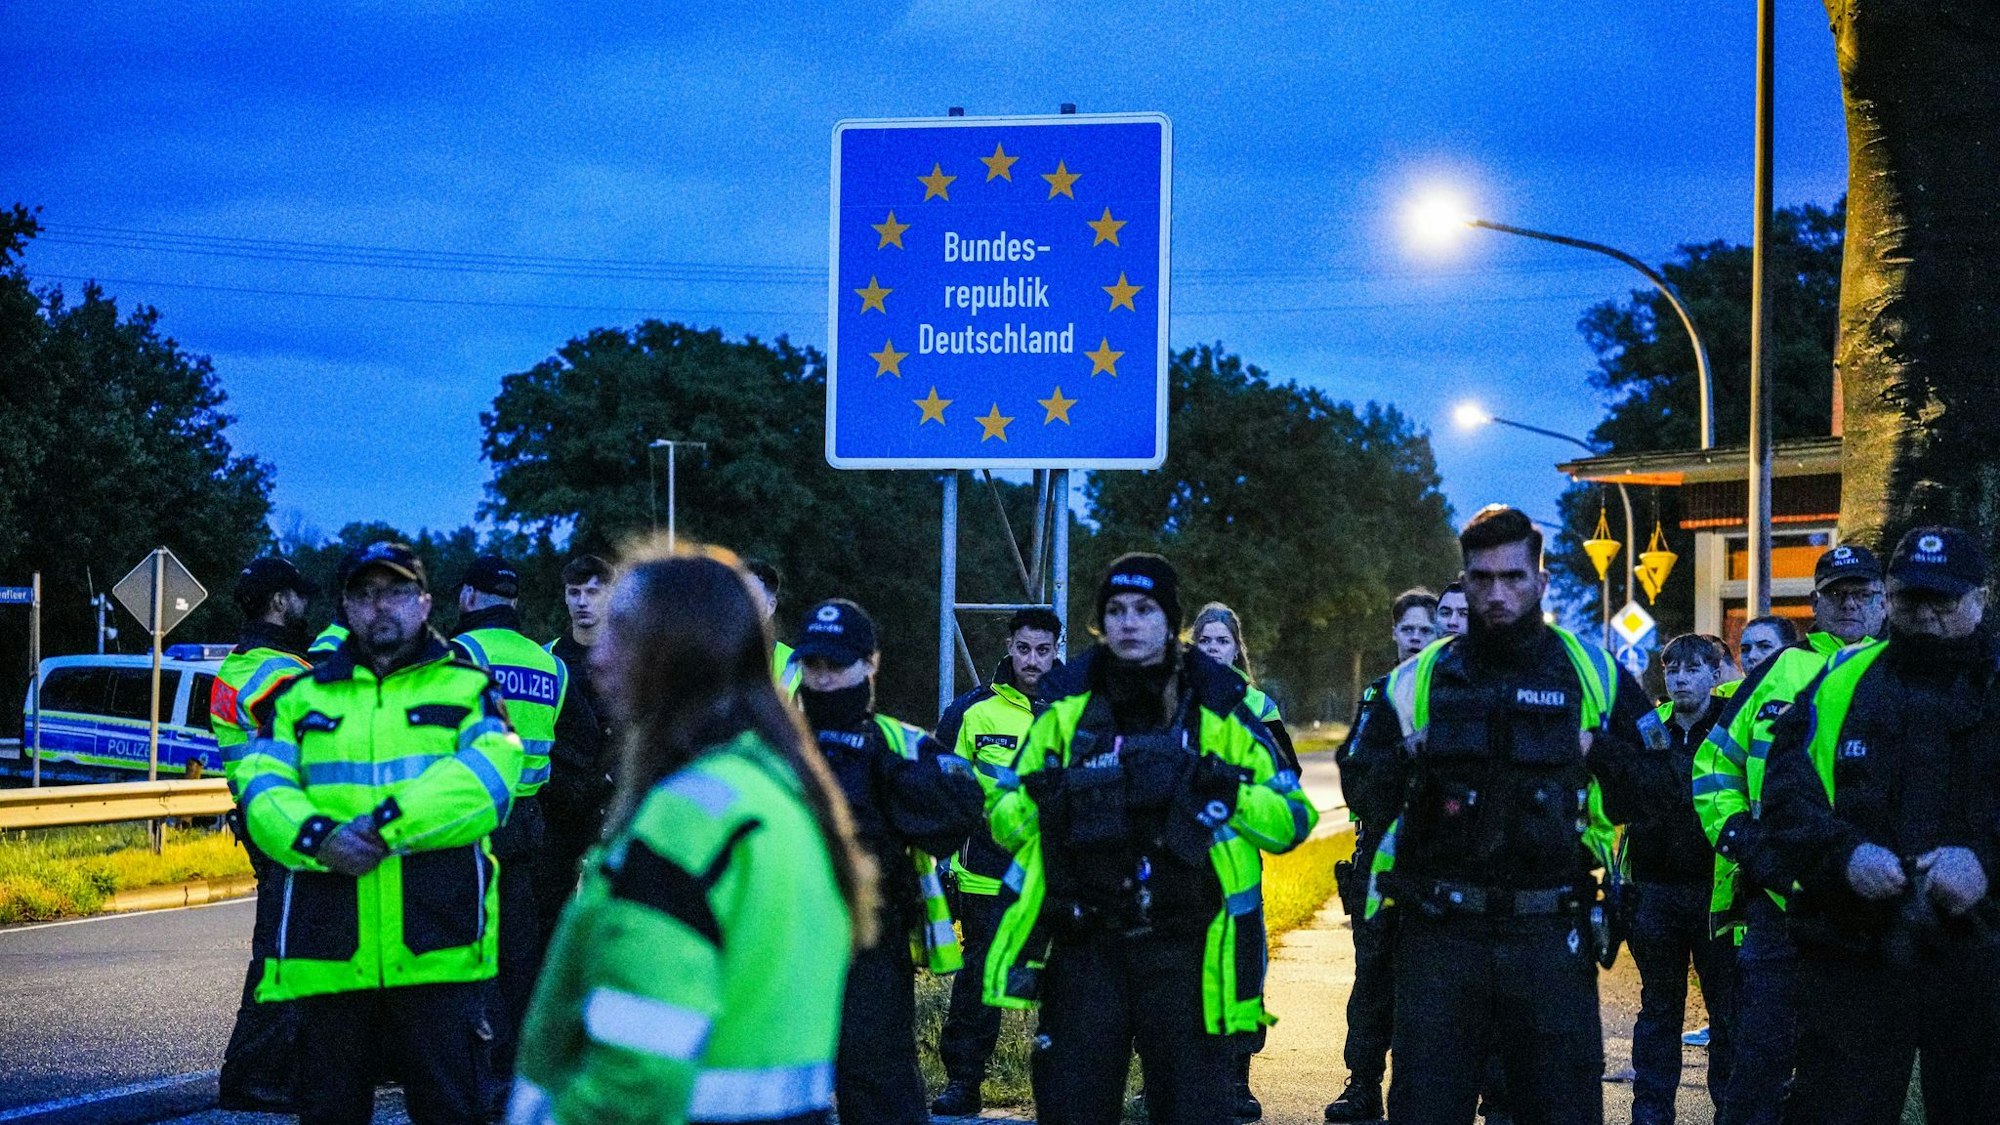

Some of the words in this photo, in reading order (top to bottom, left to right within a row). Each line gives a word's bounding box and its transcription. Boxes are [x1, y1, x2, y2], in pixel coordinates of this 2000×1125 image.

[944, 231, 1051, 262] Bundes-
[944, 277, 1050, 316] republik
[919, 323, 1075, 354] Deutschland
[495, 669, 554, 700] POLIZEI
[1516, 688, 1565, 705] POLIZEI
